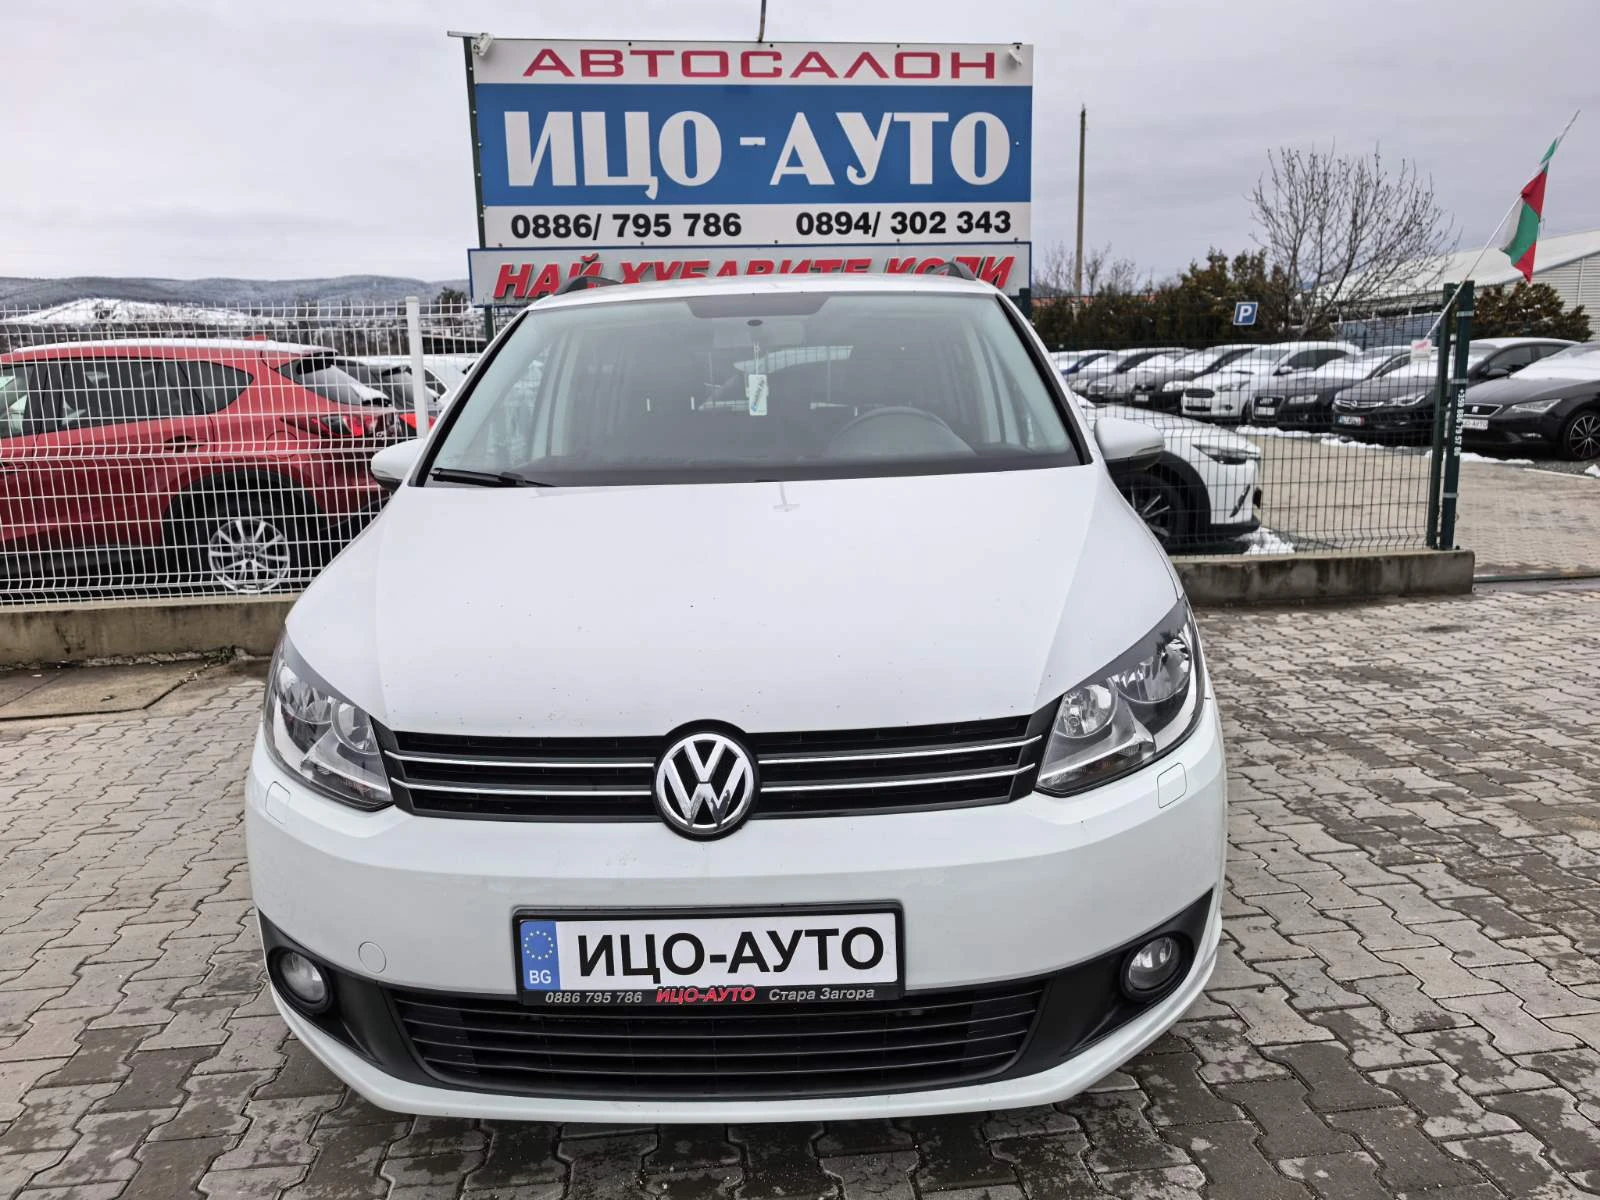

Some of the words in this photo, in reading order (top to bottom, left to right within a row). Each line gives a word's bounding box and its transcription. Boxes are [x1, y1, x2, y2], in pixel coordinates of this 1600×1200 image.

[522, 48, 996, 79] АВТОСАЛОН
[510, 213, 602, 241] 0886/
[612, 213, 672, 238] 795
[683, 212, 742, 237] 786
[795, 211, 882, 238] 0894/
[890, 211, 947, 235] 302
[956, 210, 1012, 234] 343
[1238, 305, 1252, 322] P
[577, 926, 885, 985] ИЦО-АУТО
[529, 970, 552, 984] BG
[545, 991, 581, 1004] 0886
[585, 991, 612, 1004] 795
[616, 991, 643, 1004] 786
[655, 986, 756, 1005] ИЦО-АУТО
[768, 988, 815, 1002] Стара
[820, 987, 875, 1001] Загора
